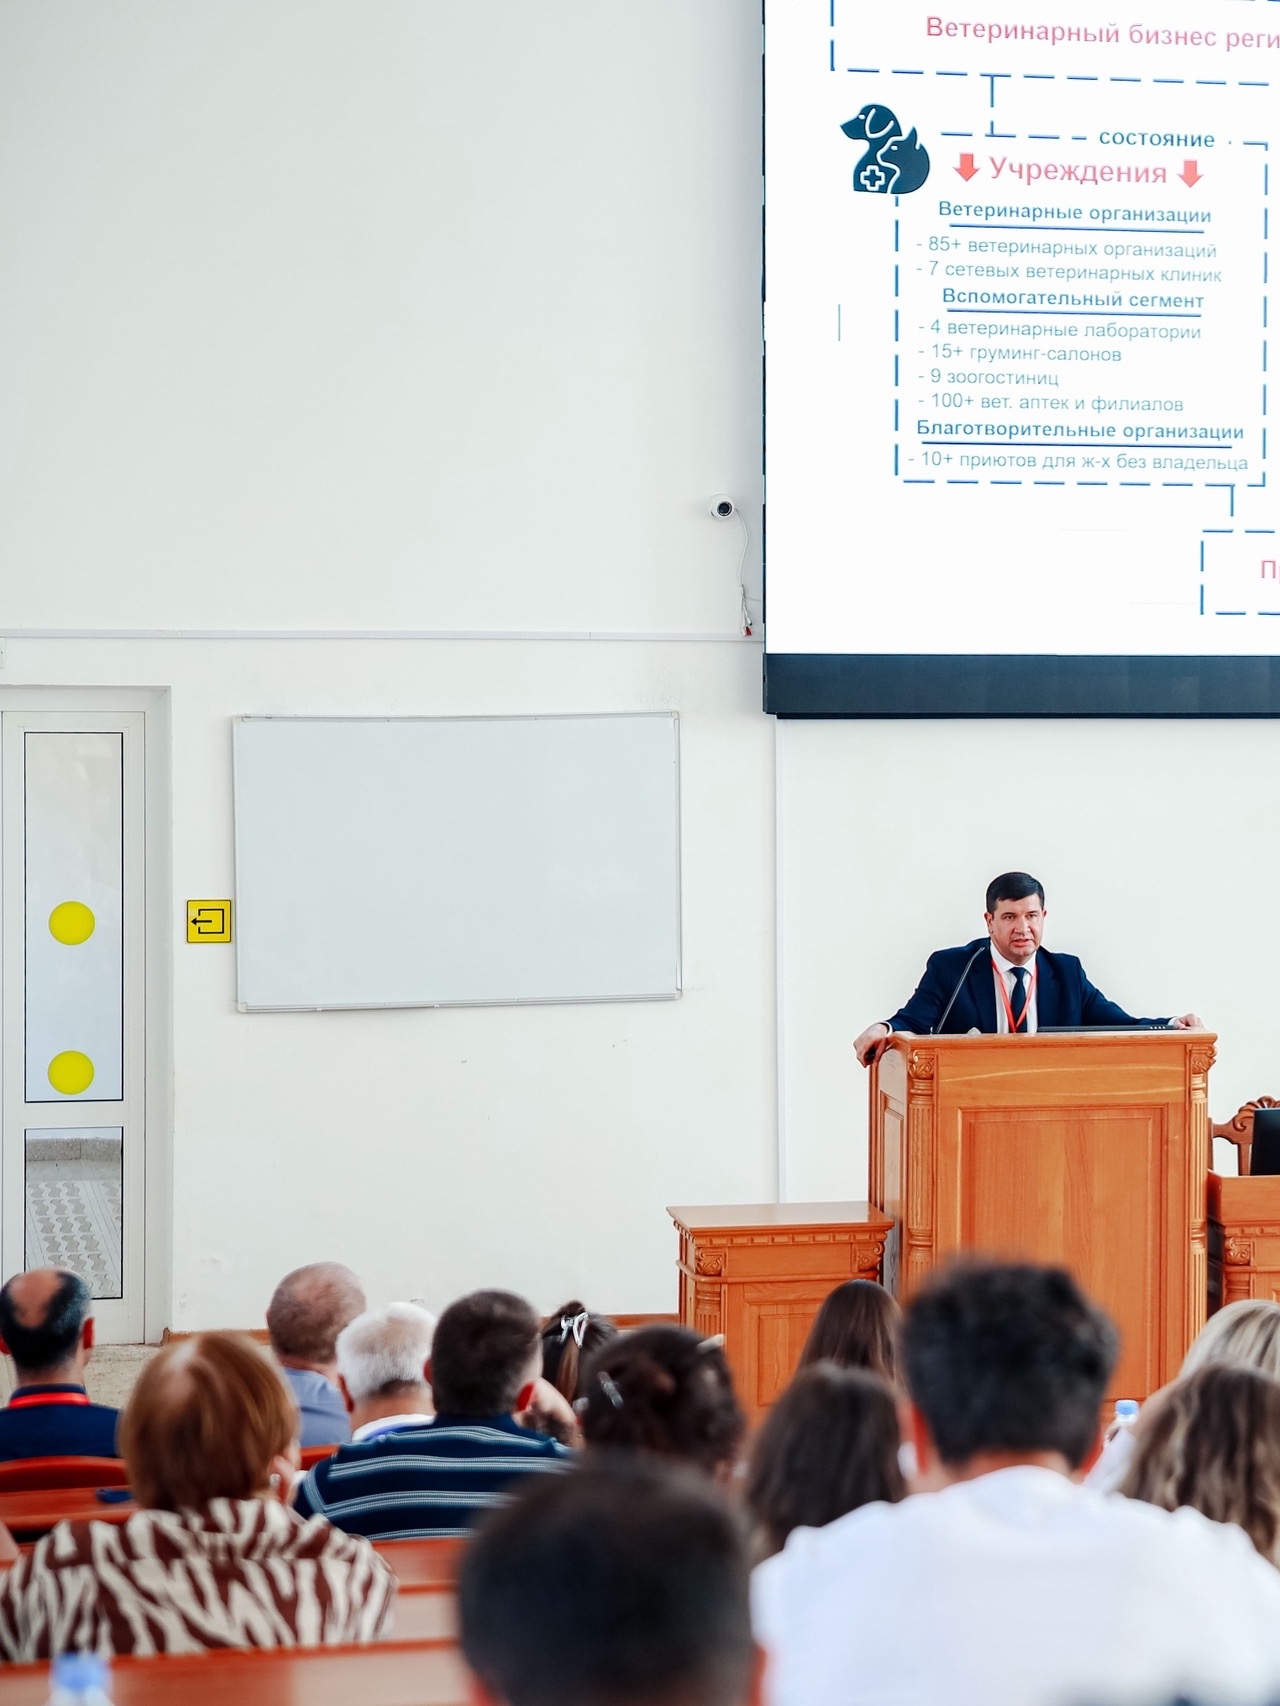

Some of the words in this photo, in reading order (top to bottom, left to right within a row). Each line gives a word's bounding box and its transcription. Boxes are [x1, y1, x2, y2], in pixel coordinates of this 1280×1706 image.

[927, 16, 1119, 45] Ветеринарный
[1129, 24, 1216, 46] бизнес
[1099, 132, 1215, 148] состояние
[989, 156, 1166, 185] Учреждения
[939, 201, 1083, 222] Ветеринарные
[1089, 208, 1211, 224] организации
[929, 236, 961, 251] 85+
[969, 241, 1097, 257] ветеринарных
[1104, 244, 1216, 259] организаций
[929, 260, 938, 275] 7
[945, 265, 1019, 277] сетевых
[1026, 267, 1154, 283] ветеринарных
[1161, 270, 1221, 282] клиник
[943, 288, 1122, 306] Вспомогательный
[1129, 296, 1204, 308] сегмент
[930, 319, 941, 333] 4
[948, 323, 1078, 339] ветеринарные
[1084, 322, 1200, 342] лаборатории
[932, 343, 963, 358] 15+
[971, 348, 1121, 363] груминг-салонов
[931, 368, 941, 383] 9
[948, 373, 1058, 387] зоогостиниц
[932, 393, 974, 408] 100+
[981, 397, 1012, 408] вет.
[1019, 398, 1068, 409] аптек
[1075, 399, 1085, 409] и
[1091, 396, 1183, 413] филиалов
[917, 419, 1116, 440] Благотворительные
[1123, 426, 1244, 441] организации
[922, 451, 953, 466] 10+
[960, 455, 1036, 470] приютов
[1042, 457, 1075, 470] для
[1082, 457, 1110, 468] ж-х
[1117, 453, 1146, 468] без
[1153, 458, 1248, 472] владельца
